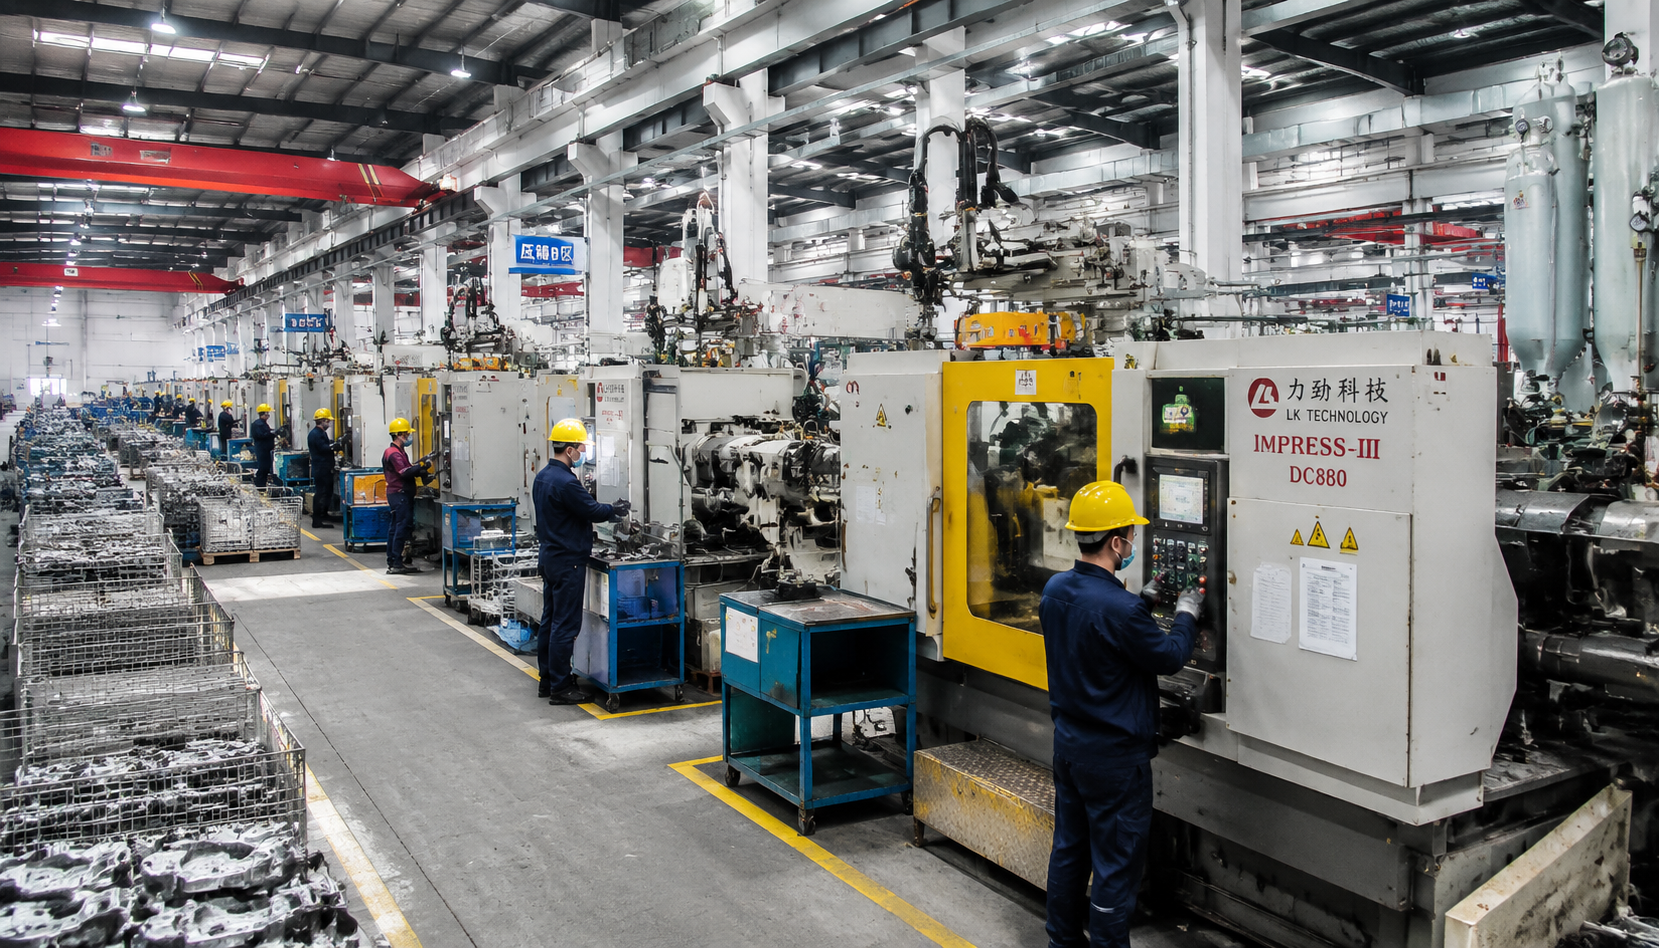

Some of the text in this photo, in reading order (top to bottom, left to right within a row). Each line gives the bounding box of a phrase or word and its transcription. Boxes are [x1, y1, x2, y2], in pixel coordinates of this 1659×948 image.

[1287, 377, 1389, 403] 力劲科技
[1286, 408, 1389, 424] LK TECHNOLOGY
[1253, 433, 1381, 460] IMPRESS-III
[1289, 465, 1348, 488] DC880
